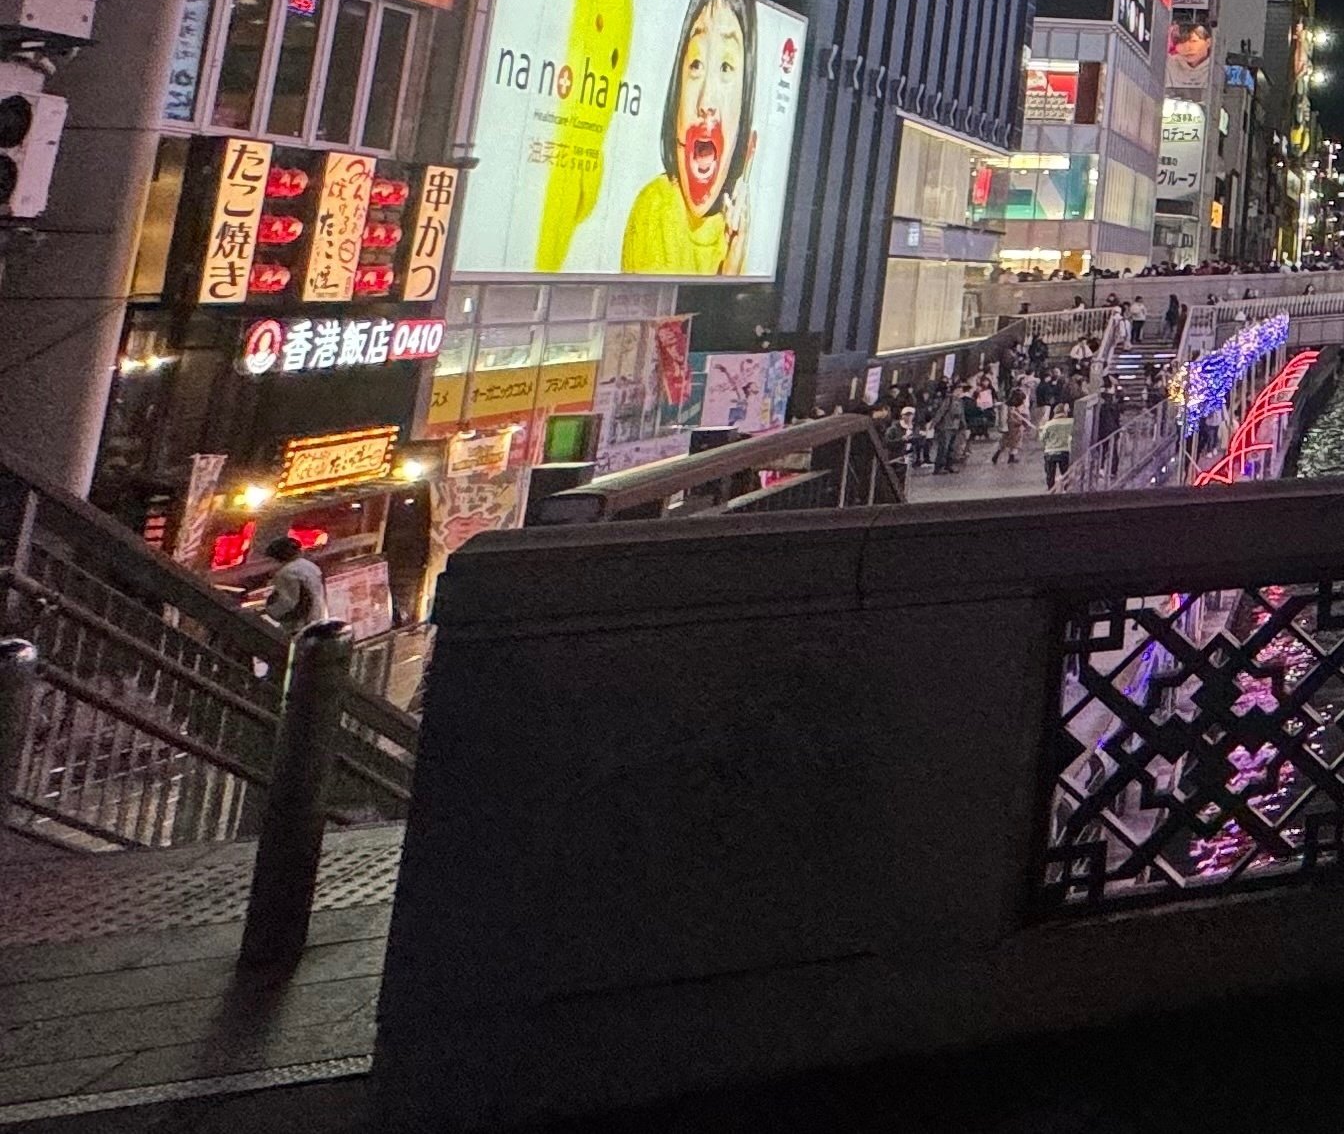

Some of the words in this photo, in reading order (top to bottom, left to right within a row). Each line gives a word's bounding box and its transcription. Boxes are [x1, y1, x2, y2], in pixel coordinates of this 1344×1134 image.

[1163, 129, 1200, 141] ロデュース
[208, 141, 266, 299] たこ焼き
[411, 171, 454, 297] 串かつ
[282, 322, 395, 371] 香港飯店
[393, 322, 444, 359] 0410
